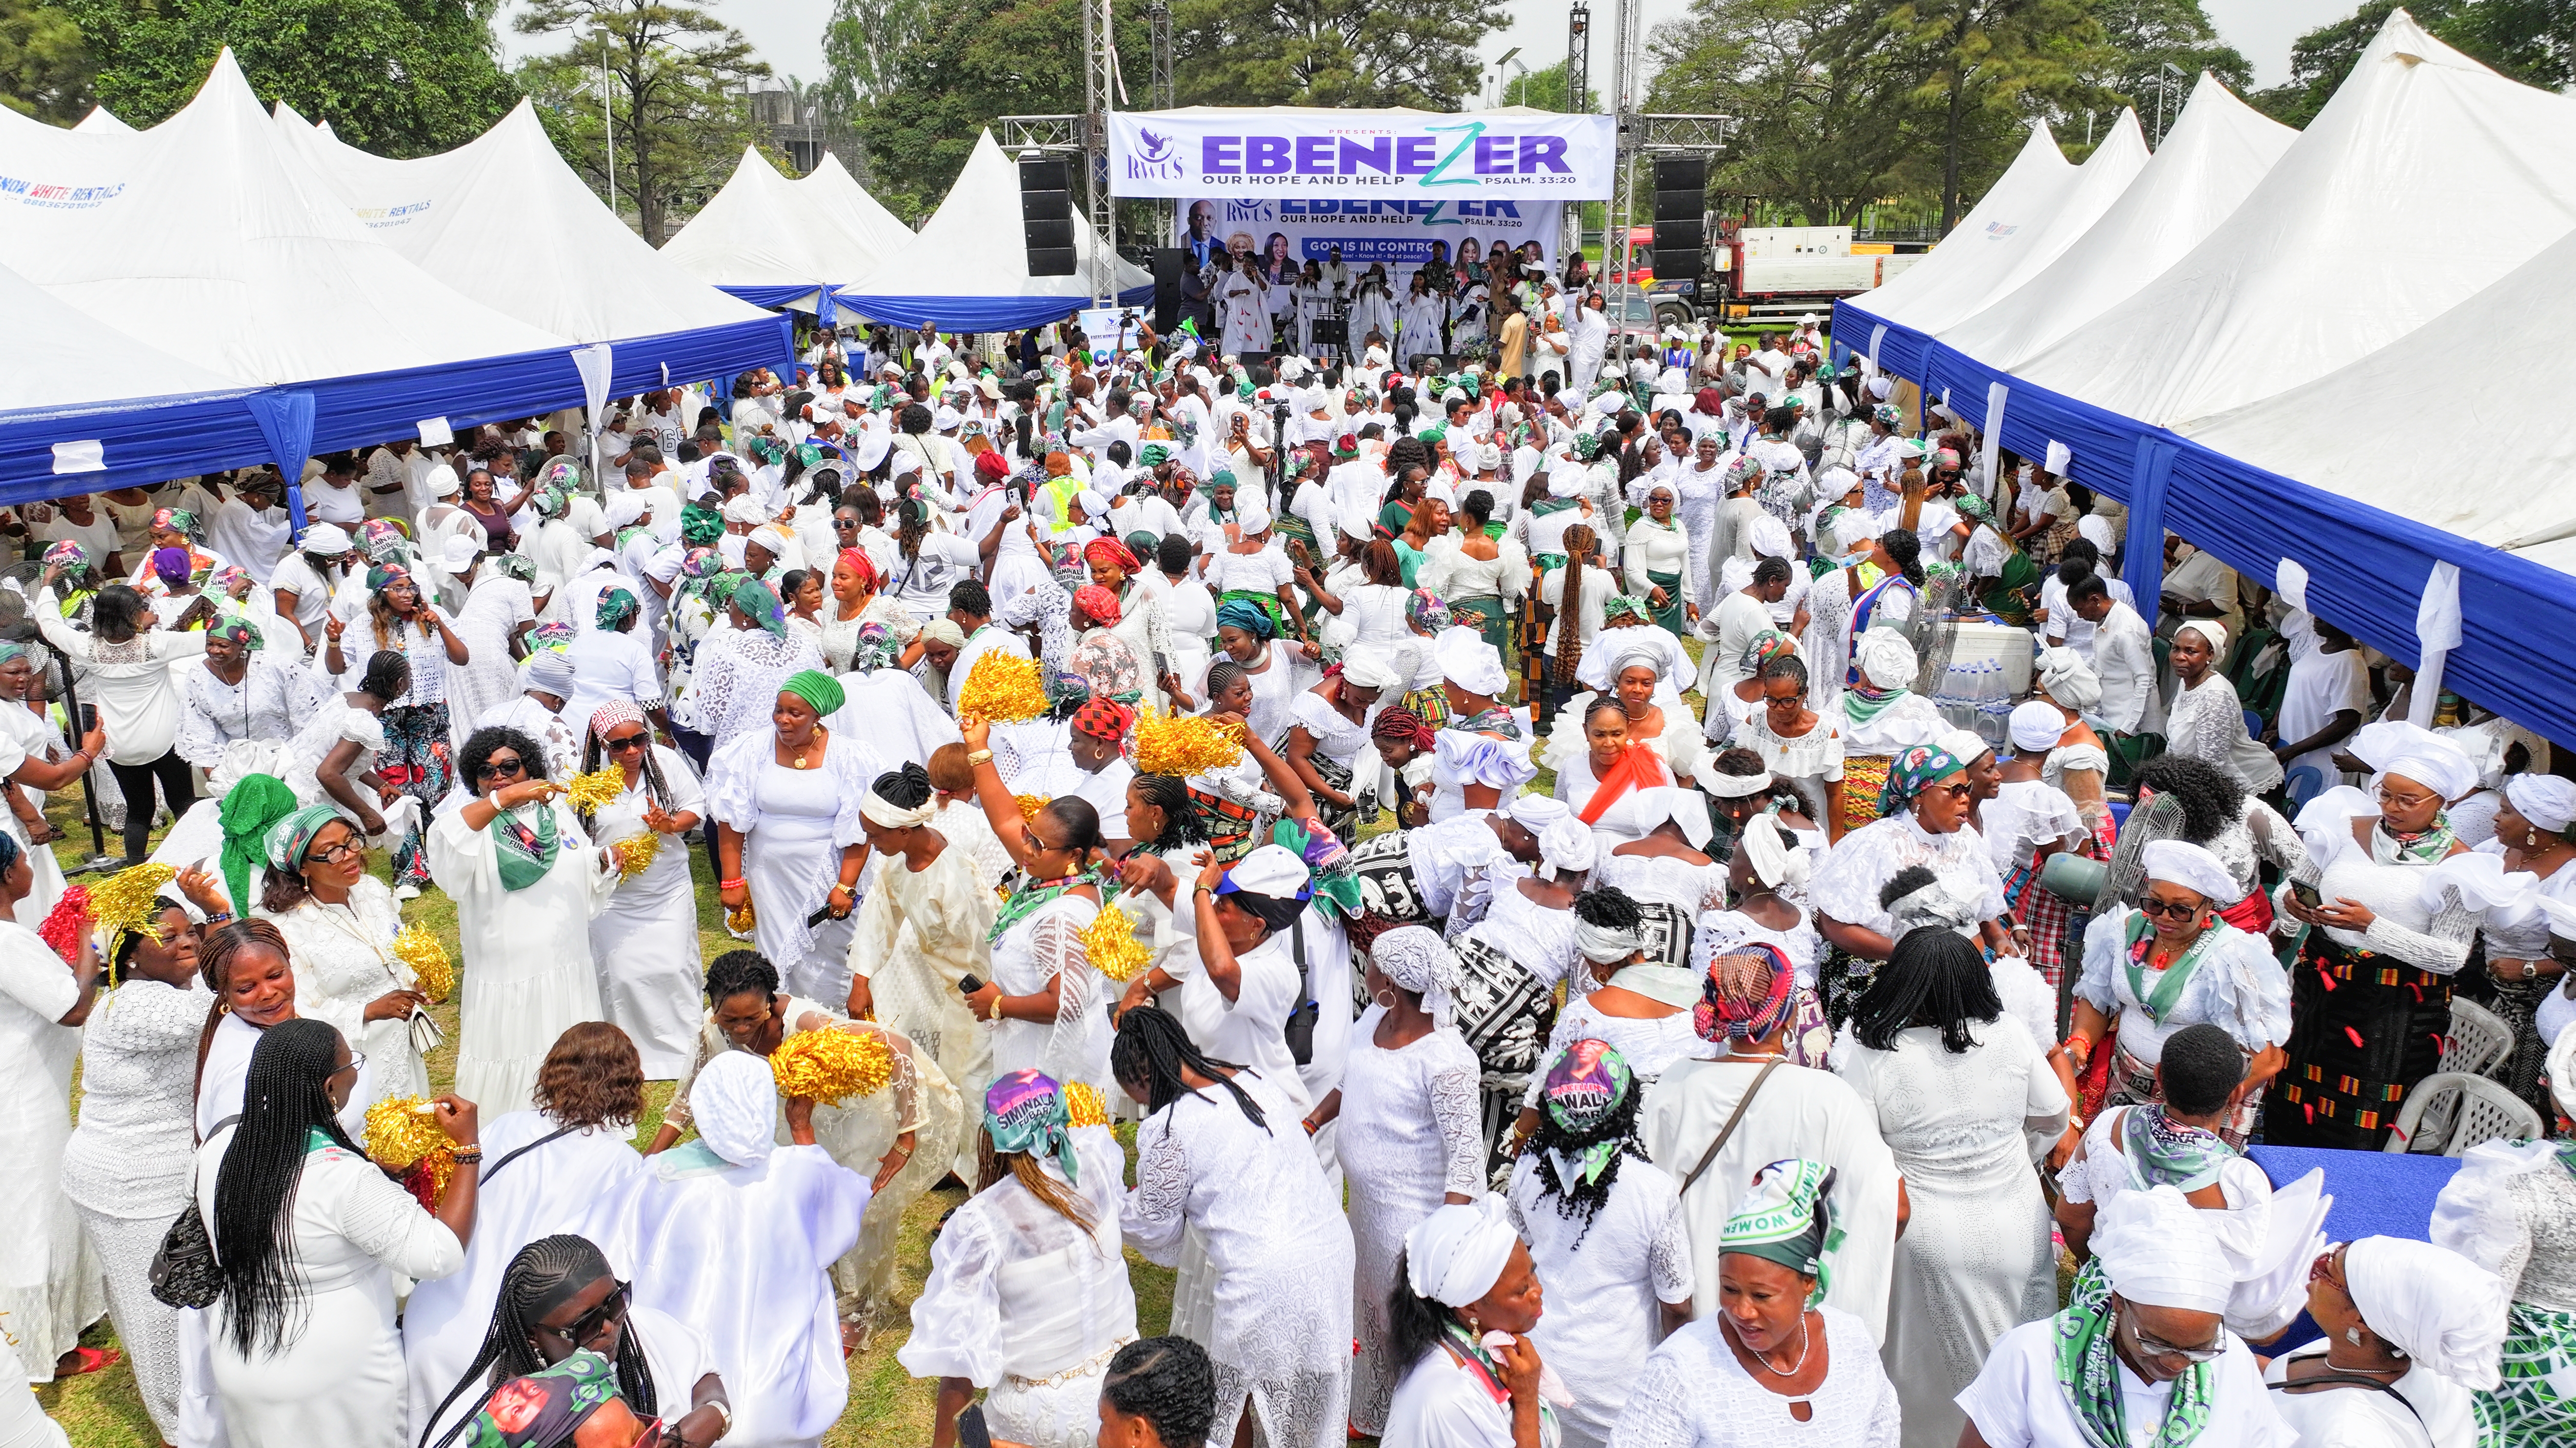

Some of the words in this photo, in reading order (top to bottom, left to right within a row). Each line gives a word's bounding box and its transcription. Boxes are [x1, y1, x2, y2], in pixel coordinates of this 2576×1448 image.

[1203, 122, 1573, 187] EBENEZER
[1127, 154, 1183, 180] RWUS
[1203, 176, 1242, 184] OUR
[1249, 176, 1301, 184] HOPE
[1308, 176, 1348, 185] AND
[1356, 176, 1405, 185] HELP
[30, 184, 72, 200] WHITE
[70, 183, 125, 201] RENTALS
[389, 200, 431, 217] RENTALS
[1226, 201, 1272, 222] RWUS
[1344, 241, 1356, 251] IS
[1360, 241, 1374, 251] IN
[1378, 242, 1433, 252] CONTRO
[907, 554, 947, 592] 12
[1320, 855, 1331, 865] HIS
[2191, 929, 2209, 956] RIVERS
[2166, 1142, 2195, 1152] RIVERS
[2083, 1333, 2103, 1391] FUBARA
